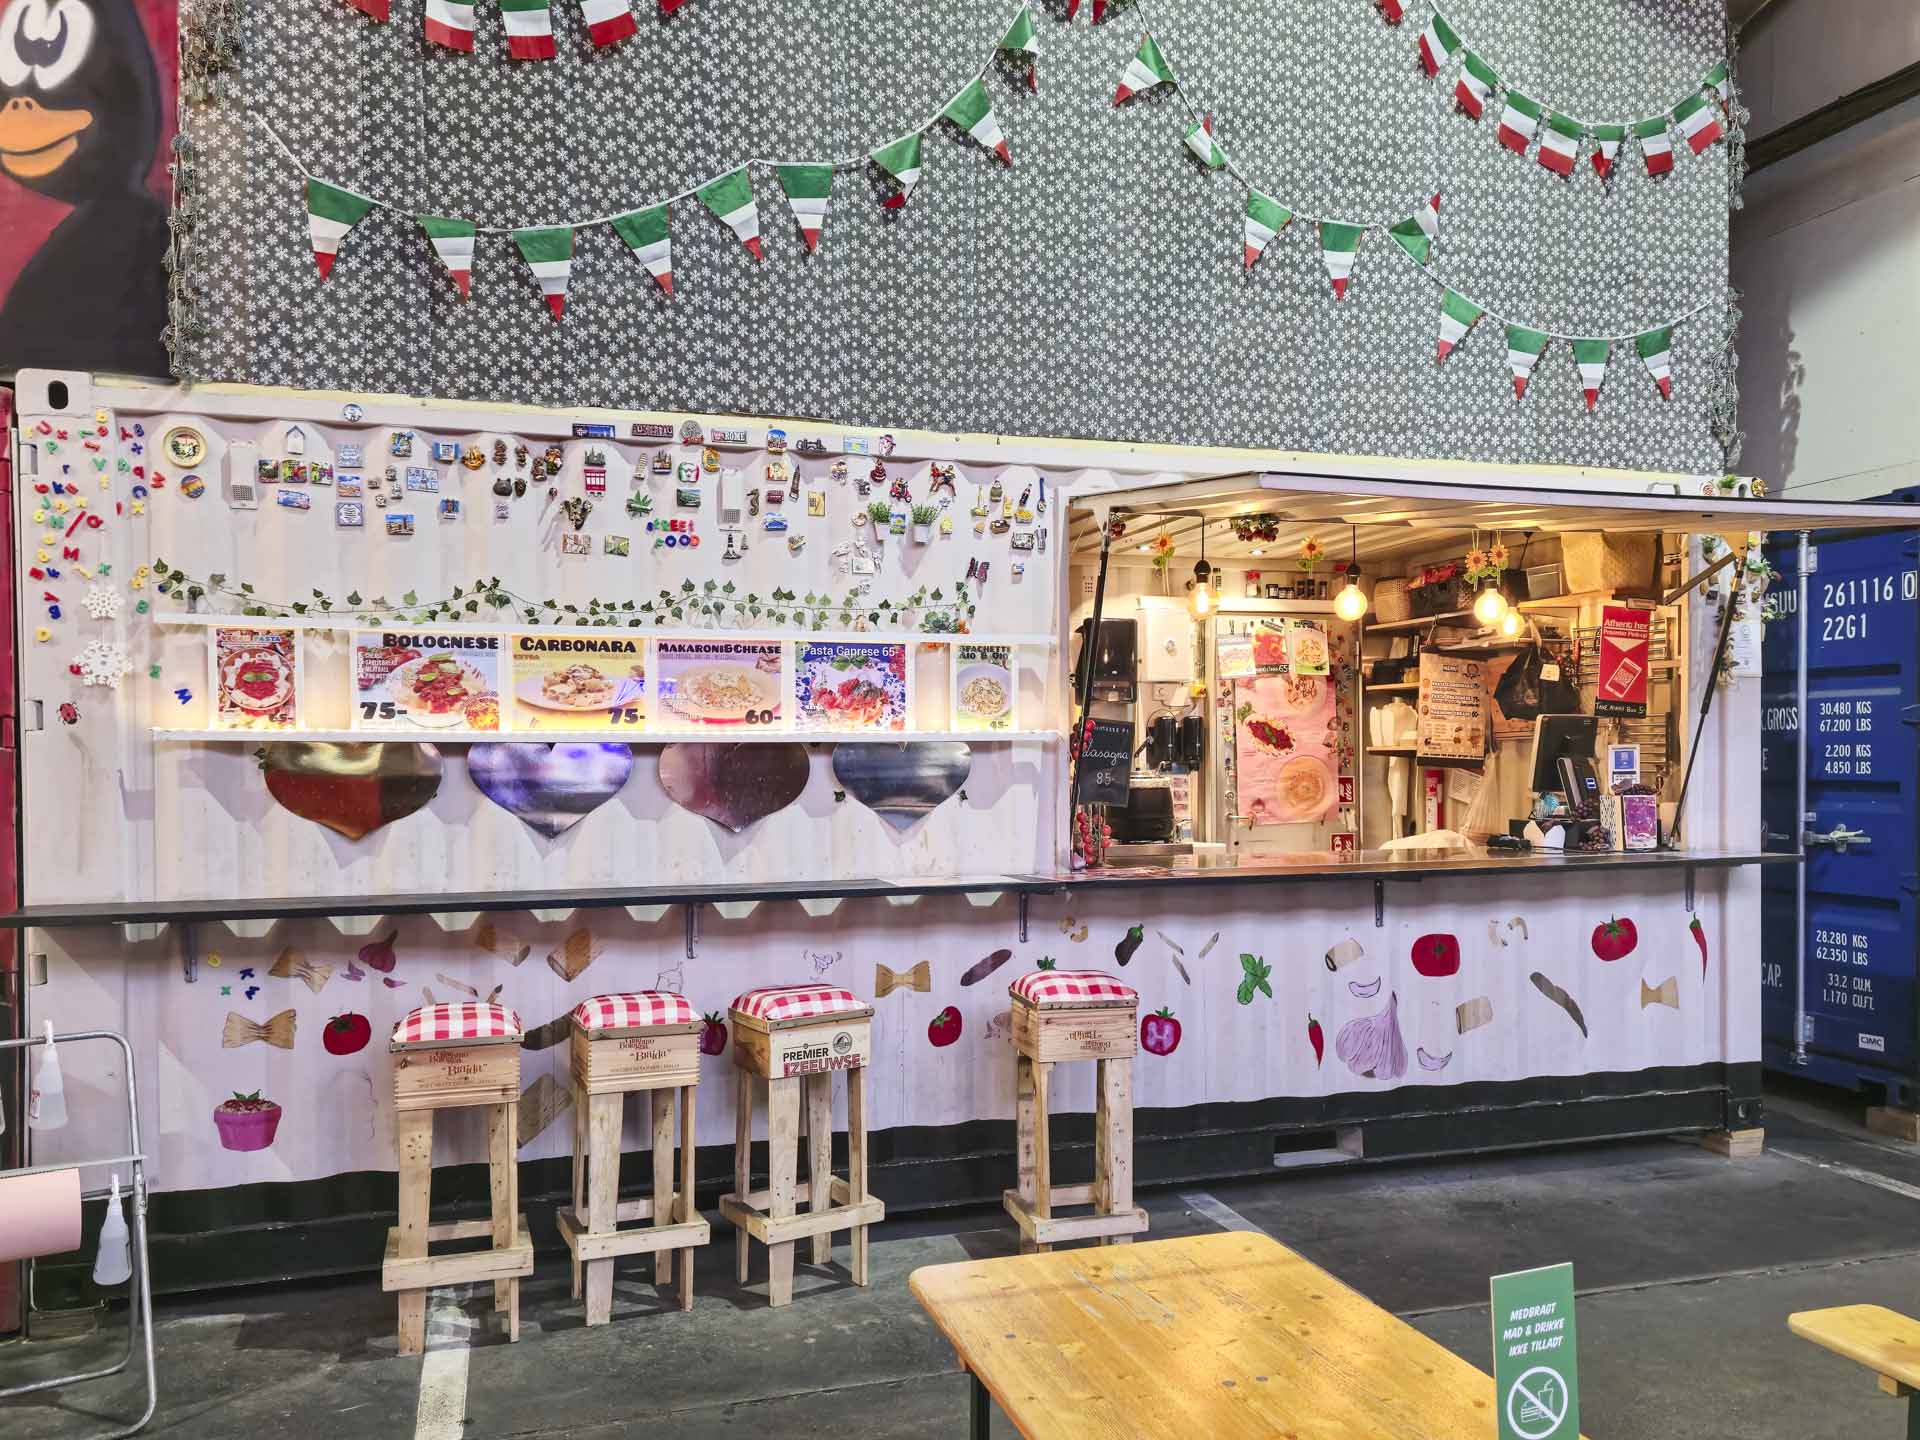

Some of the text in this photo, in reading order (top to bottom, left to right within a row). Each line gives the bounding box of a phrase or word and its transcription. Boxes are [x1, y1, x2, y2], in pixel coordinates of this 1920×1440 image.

[1823, 576, 1893, 608] 261116
[1904, 573, 1915, 598] 0
[1823, 613, 1866, 641] 22G1
[382, 633, 499, 650] BOLOGNESE
[520, 637, 636, 653] CARBONARA
[803, 646, 833, 656] Pasta
[836, 646, 880, 657] Caprese
[745, 709, 782, 725] 60-
[1819, 702, 1851, 716] 30.480
[1856, 701, 1872, 715] KGS
[1819, 719, 1872, 732] 67.200 LBS
[1825, 744, 1872, 758] 2.200 KGS
[1825, 761, 1872, 775] 4.850 LBS
[1816, 930, 1868, 949] 28.280 KGS
[1816, 946, 1868, 966] 62.350 LBS
[1828, 973, 1848, 988] 33.2
[1823, 988, 1848, 1005] 1.170
[783, 1047, 829, 1062] PREMIER
[791, 1053, 861, 1076] ZEEUWSE
[1510, 1302, 1557, 1322] MEDBRAGT
[1503, 1317, 1565, 1342] MAD & DRIKKE
[1508, 1335, 1564, 1358] IKKE TILLADT
